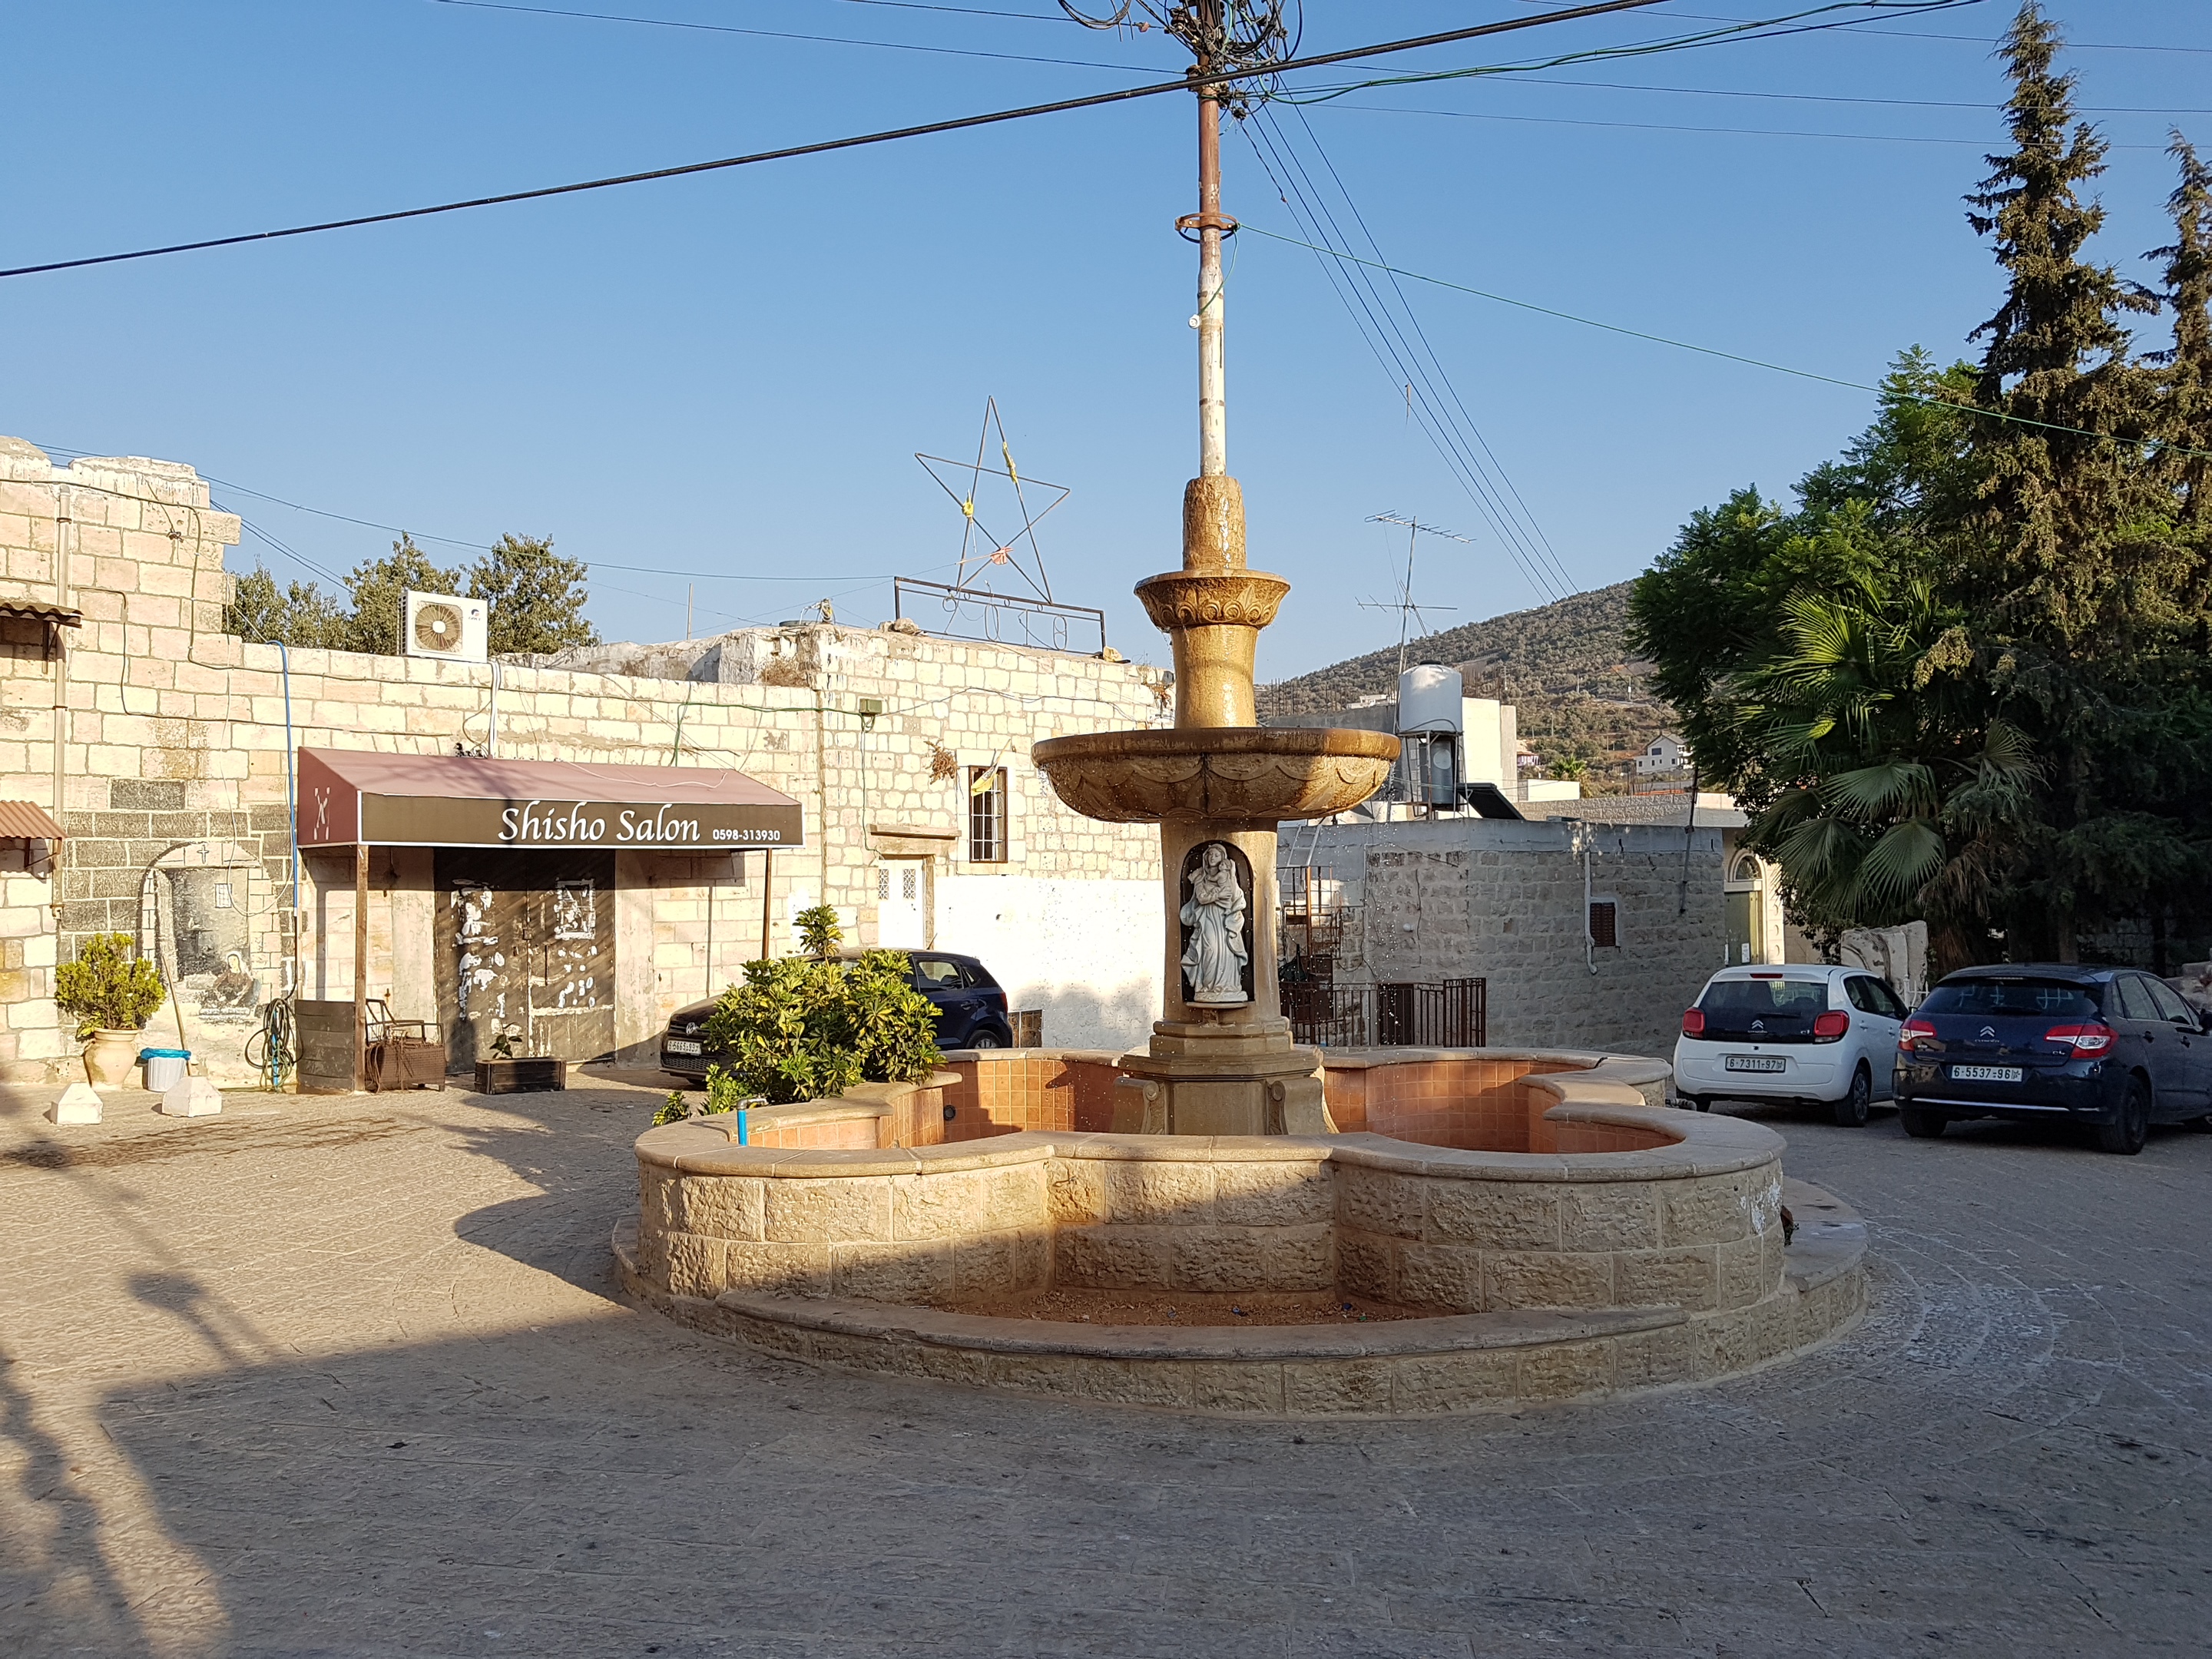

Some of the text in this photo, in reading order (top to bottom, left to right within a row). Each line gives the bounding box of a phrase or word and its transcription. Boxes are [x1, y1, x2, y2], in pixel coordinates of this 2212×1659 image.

[498, 800, 781, 843] Shisho Salon 0598-313930
